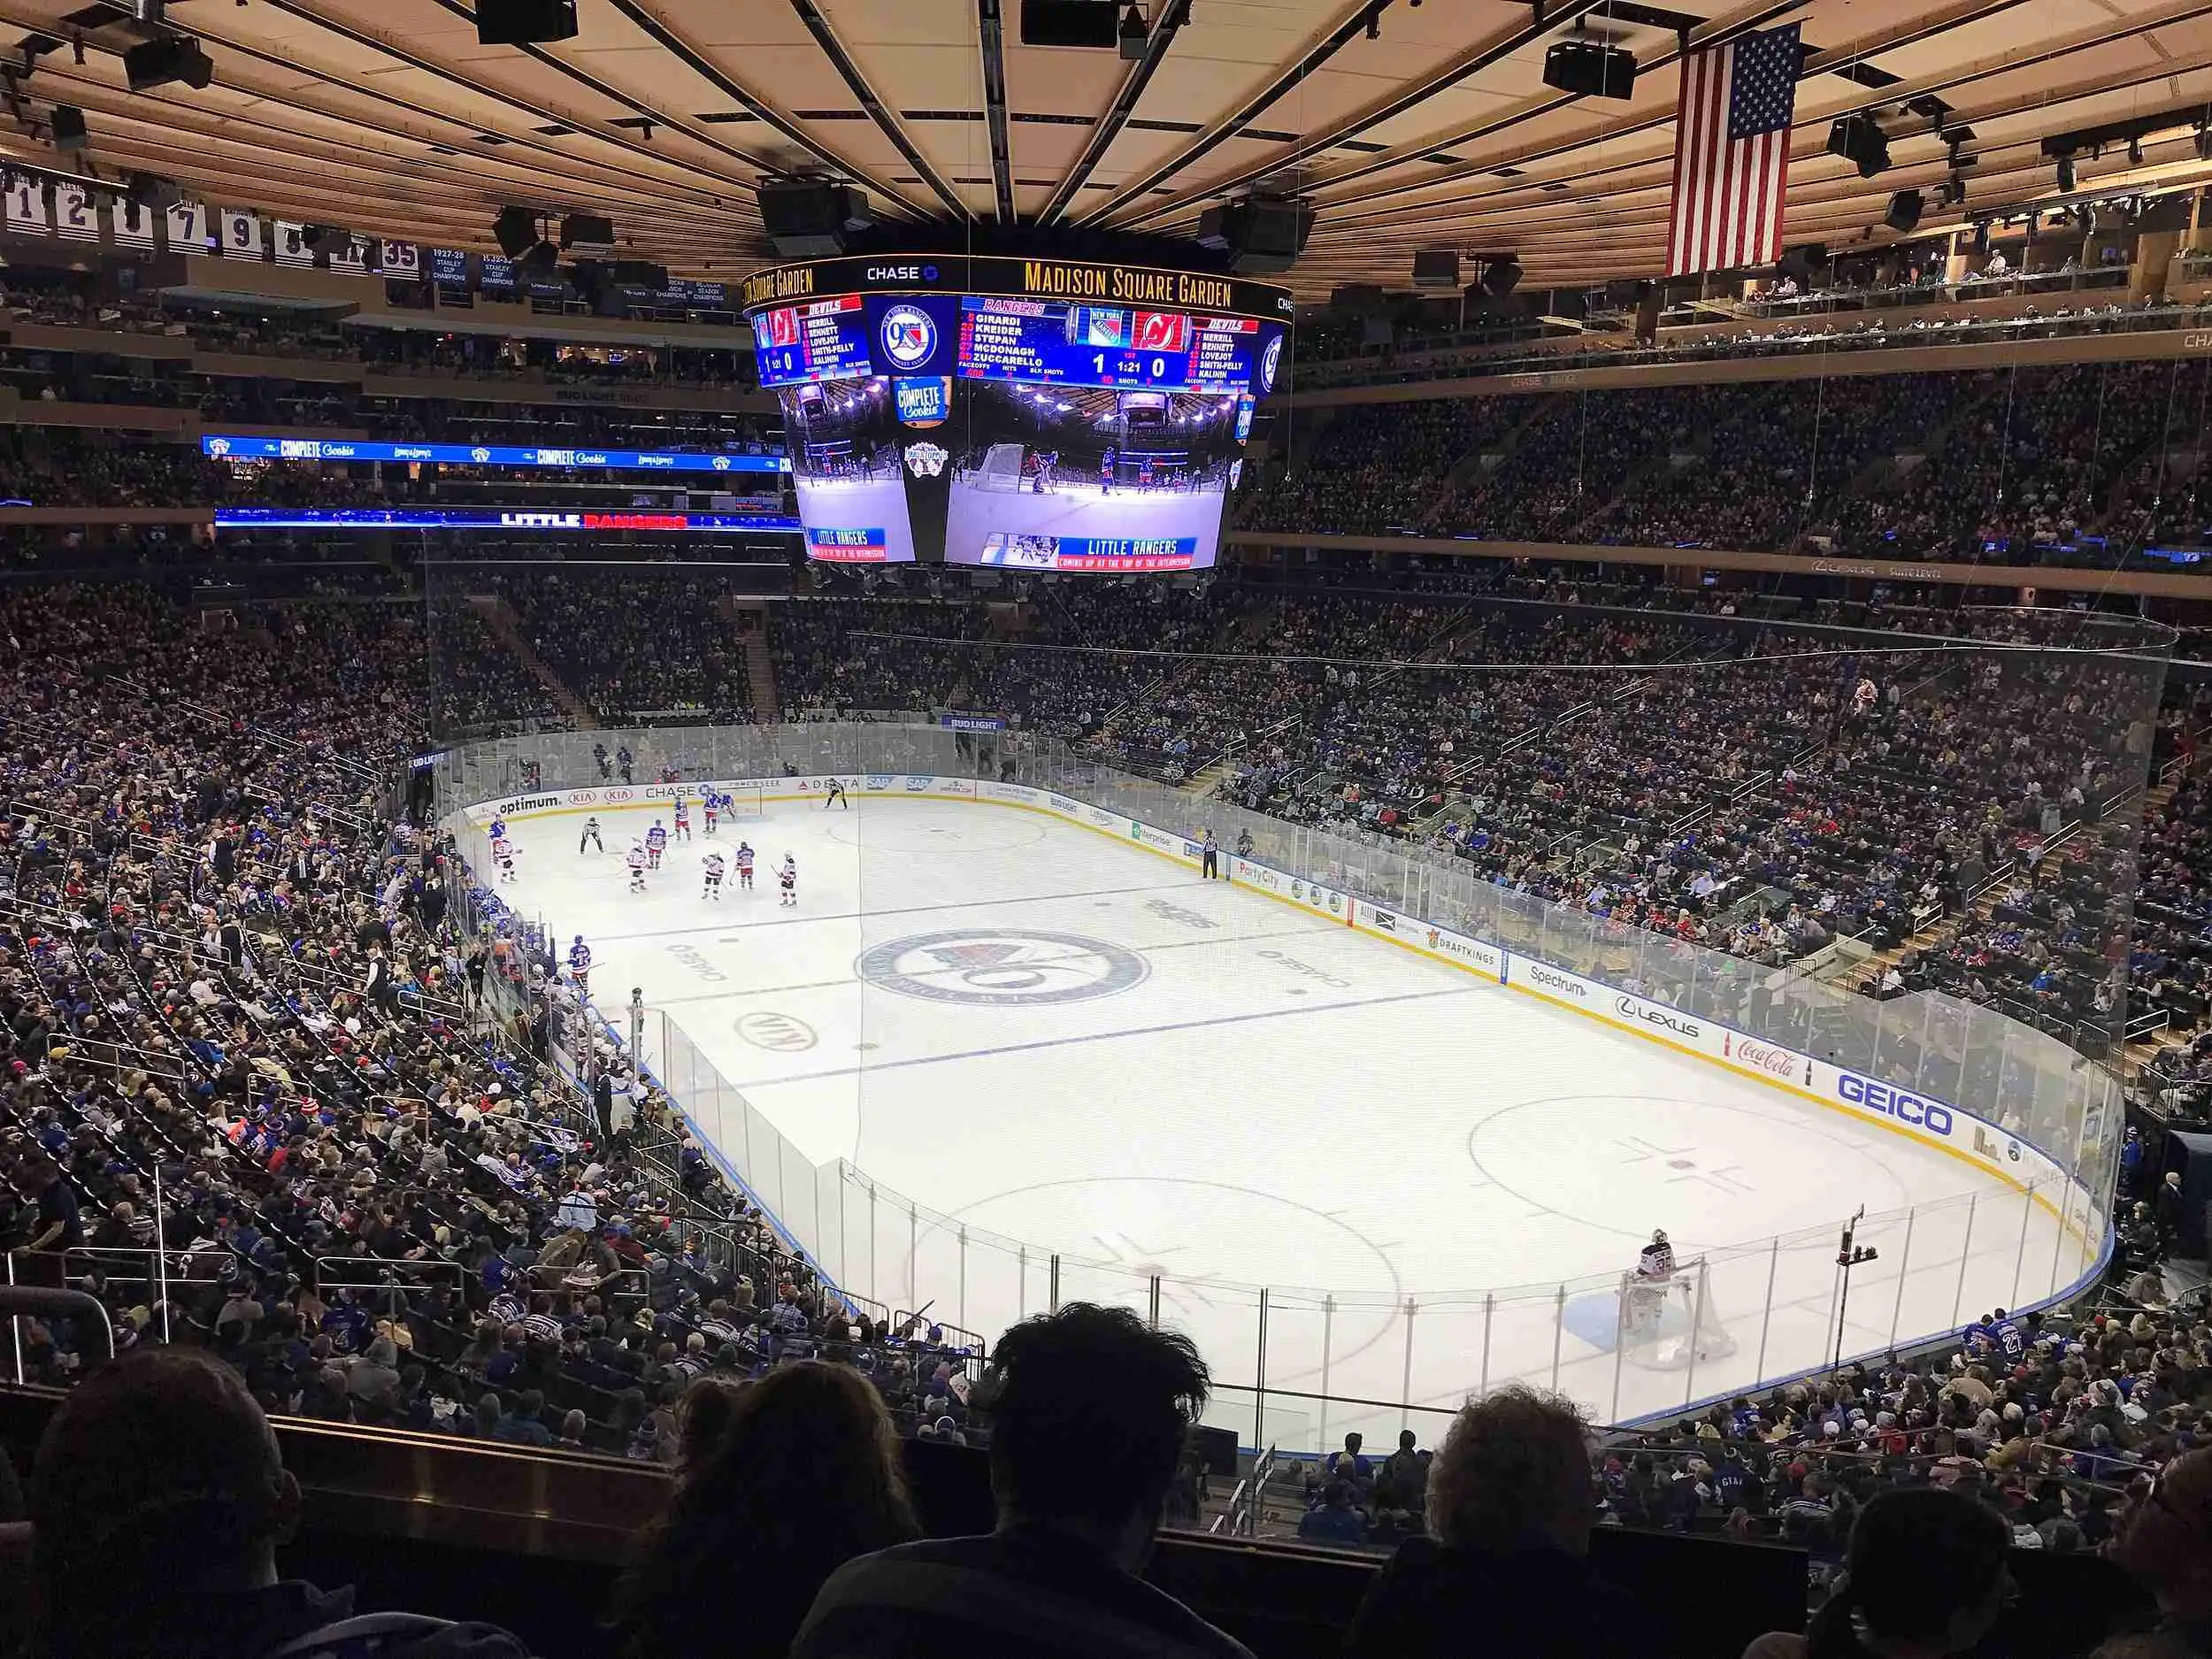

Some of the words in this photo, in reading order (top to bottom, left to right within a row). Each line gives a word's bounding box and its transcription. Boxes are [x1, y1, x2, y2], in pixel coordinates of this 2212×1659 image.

[67, 194, 86, 226] 2
[178, 210, 194, 240] 7
[233, 218, 250, 248] 9
[384, 240, 418, 265] 35
[867, 266, 920, 280] CHASE
[777, 268, 813, 297] GARDEN
[1025, 262, 1106, 296] MADISON
[1112, 268, 1174, 301] SQUARE
[1179, 274, 1232, 307] GARDEN
[808, 299, 841, 316] DEVILS
[976, 314, 1020, 326] GIRARDI
[1209, 319, 1244, 332] DEVILS
[975, 324, 1023, 337] KREIDER
[1202, 333, 1233, 343] MERRILL
[810, 335, 840, 347] LOVEJOY
[974, 334, 1017, 345] STEPAN
[1202, 342, 1234, 352] BENNETT
[973, 343, 1035, 357] MCDONAGH
[1201, 351, 1233, 361] LOVEJOY
[973, 352, 1043, 367] ZUCCARELLO
[1093, 354, 1104, 373] 1
[1118, 361, 1141, 373] 1:21
[1152, 357, 1164, 377] 0
[1199, 360, 1243, 371] SMITH-PELLY
[1198, 370, 1227, 379] KALININ
[897, 387, 940, 408] COMPLETE
[903, 405, 938, 419] Cookie
[280, 441, 321, 457] COMPLETE
[322, 444, 355, 457] Cookie
[537, 449, 574, 465] COMPLETE
[576, 452, 608, 465] Cookie
[502, 513, 580, 528] LITTLE
[584, 514, 688, 531] RANGERS
[818, 531, 836, 545] LITTLE
[837, 531, 868, 546] RANGERS
[1087, 540, 1127, 556] LITTLE
[1132, 540, 1178, 556] RANGERS
[951, 718, 971, 728] BUD
[971, 720, 999, 730] LIGHT
[572, 791, 593, 804] KIA
[609, 789, 630, 802] KIA
[645, 786, 695, 799] CHASE
[1439, 938, 1494, 965] DRAFTKINGS
[1530, 966, 1585, 997] Spectrum
[1638, 1007, 1700, 1038] LEXUS
[1838, 1073, 1954, 1137] GEICO
